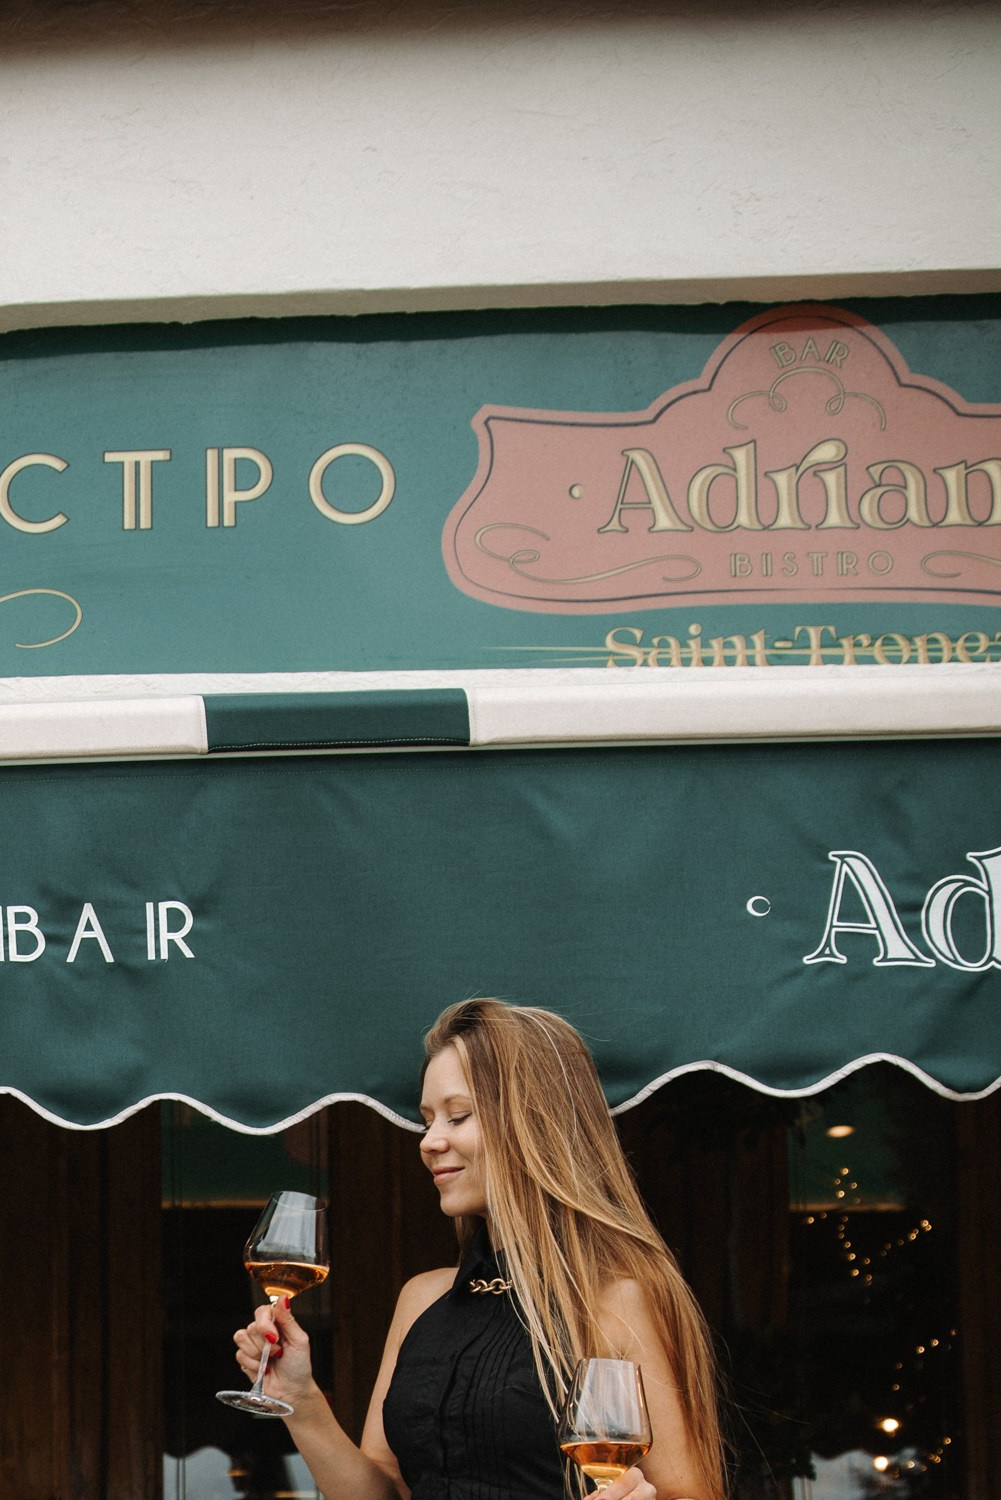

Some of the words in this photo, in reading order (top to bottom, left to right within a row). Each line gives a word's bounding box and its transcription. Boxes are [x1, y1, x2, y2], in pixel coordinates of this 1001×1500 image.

[770, 336, 851, 369] BAR
[598, 438, 1001, 534] Adrian
[730, 550, 895, 578] BISTRO
[605, 623, 1001, 668] Saint-Trope
